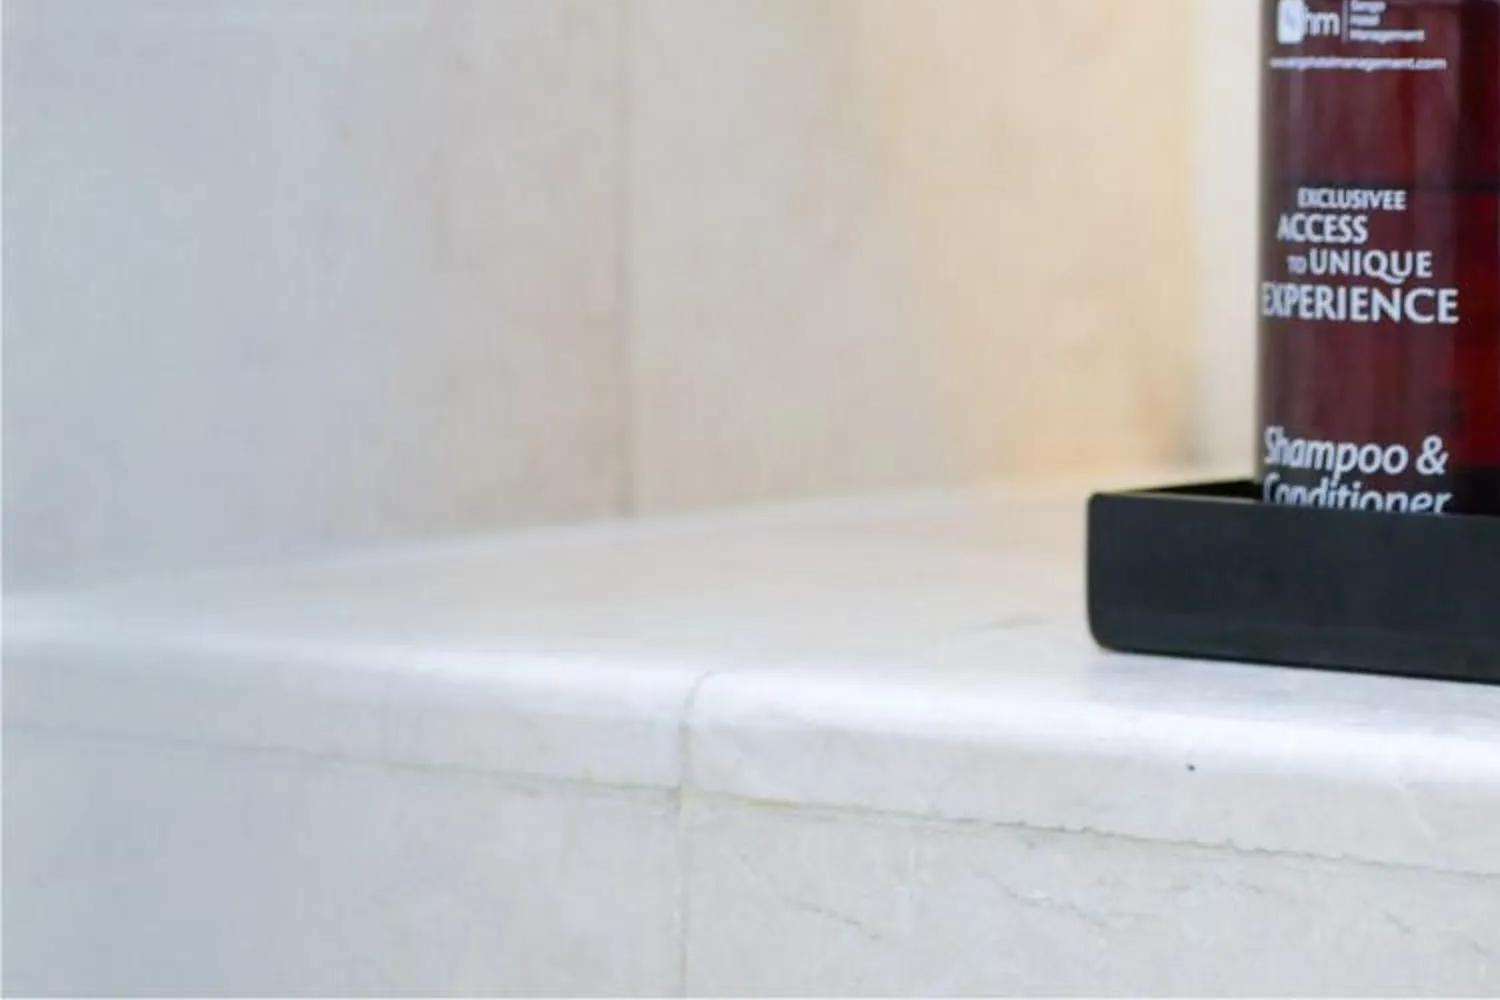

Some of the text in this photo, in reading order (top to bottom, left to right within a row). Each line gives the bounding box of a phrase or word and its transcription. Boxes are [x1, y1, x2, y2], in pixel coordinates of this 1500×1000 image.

[1297, 187, 1408, 211] EXCLUSIVEE
[1276, 213, 1369, 244] ACCESS
[1309, 248, 1433, 284] UNIQUE
[1260, 280, 1461, 325] EXPERIENCE
[1263, 425, 1450, 485] Shampoo &
[1263, 471, 1453, 514] Conditioner
